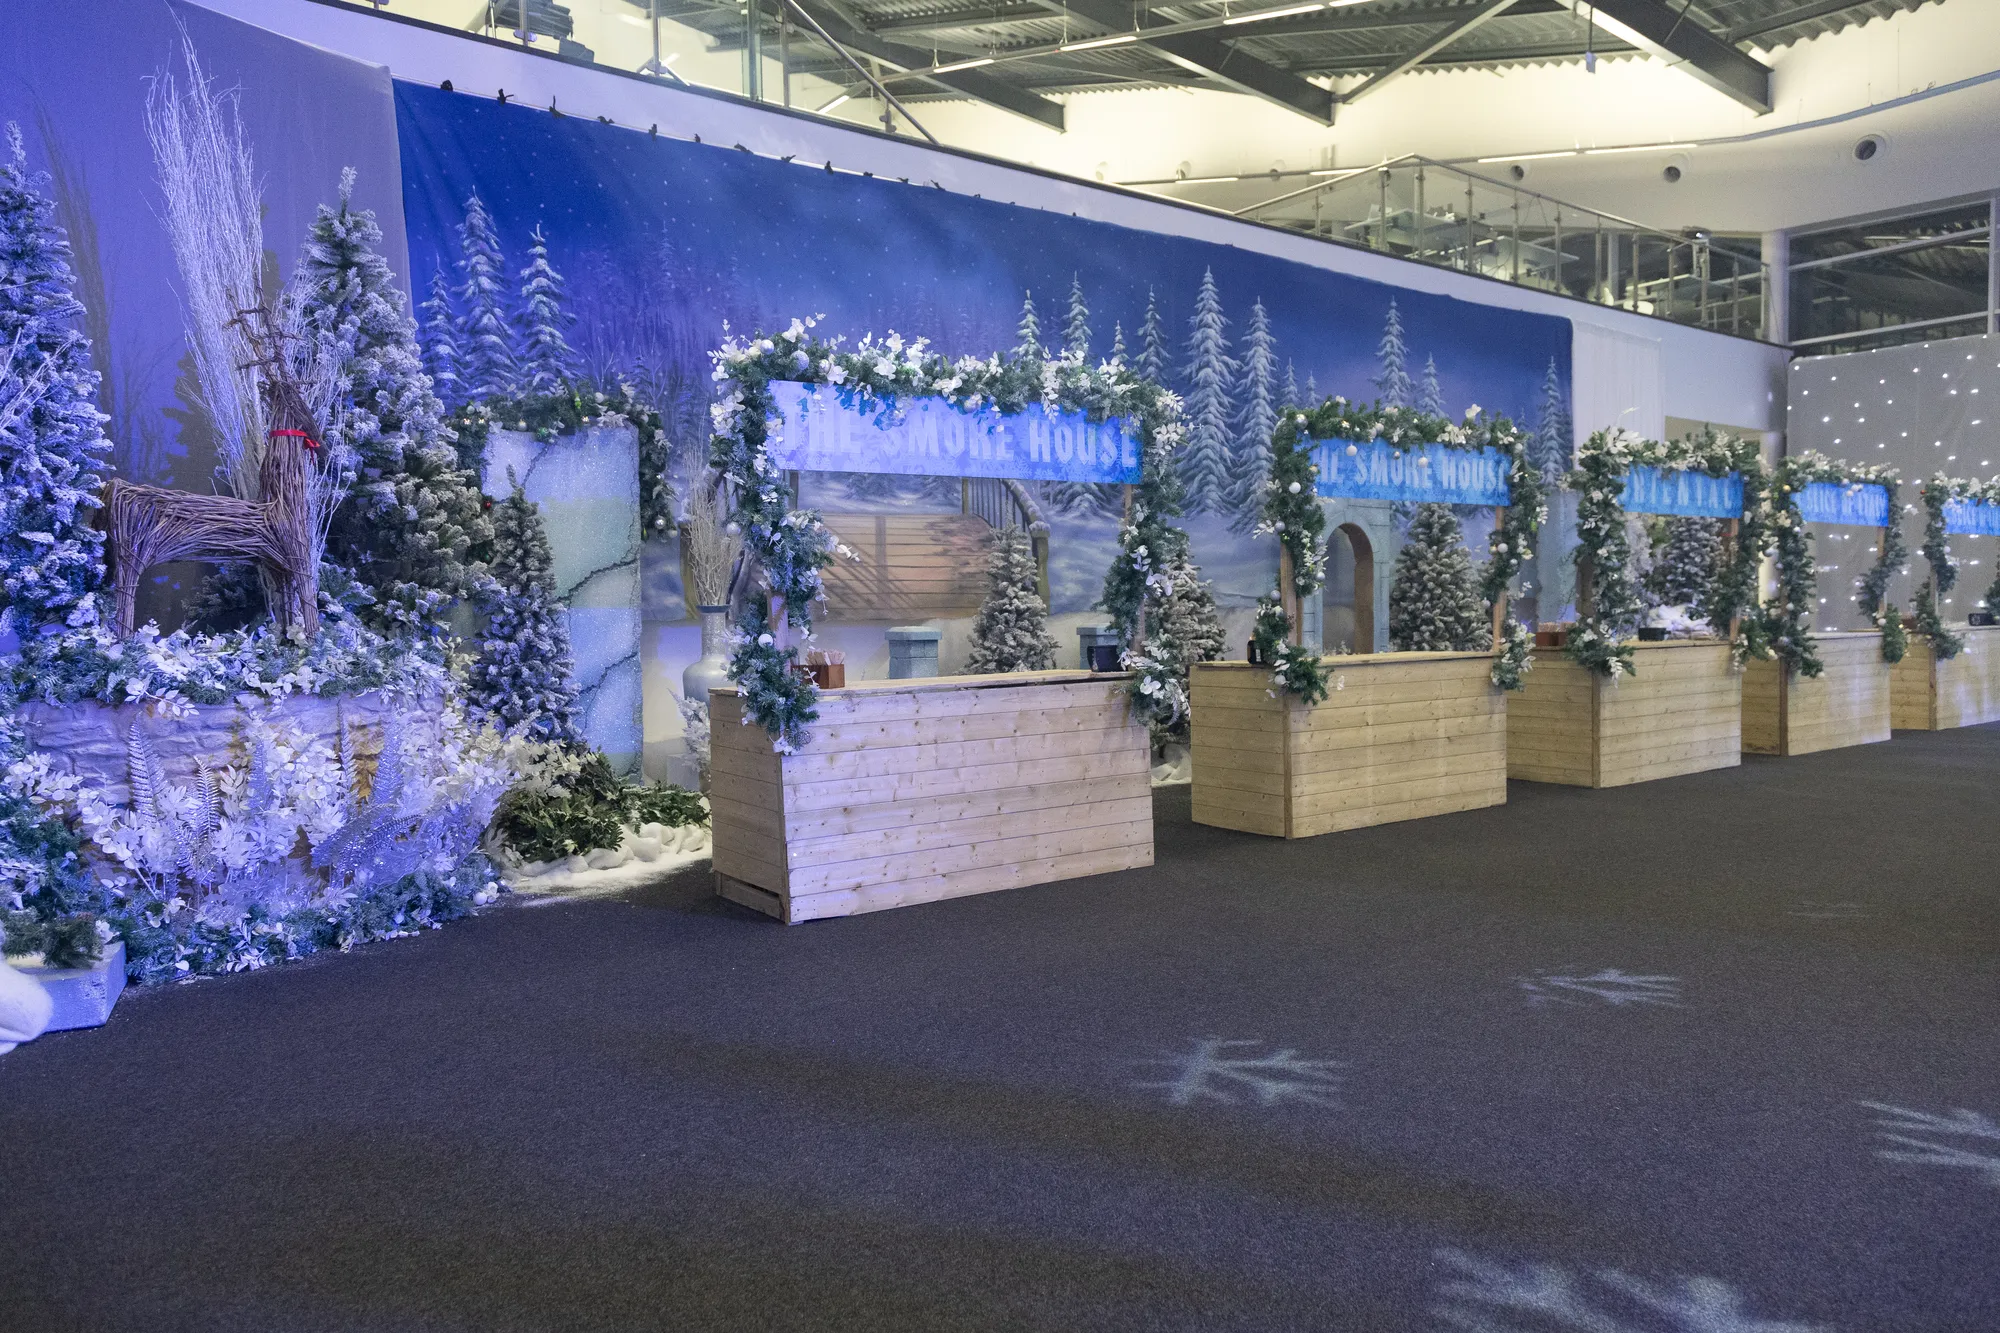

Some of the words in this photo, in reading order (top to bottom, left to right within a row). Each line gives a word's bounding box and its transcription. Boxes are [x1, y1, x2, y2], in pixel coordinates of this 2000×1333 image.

[1029, 417, 1138, 468] HOUSE
[1355, 450, 1433, 489] SMOKE
[1442, 455, 1507, 493] HOUSE
